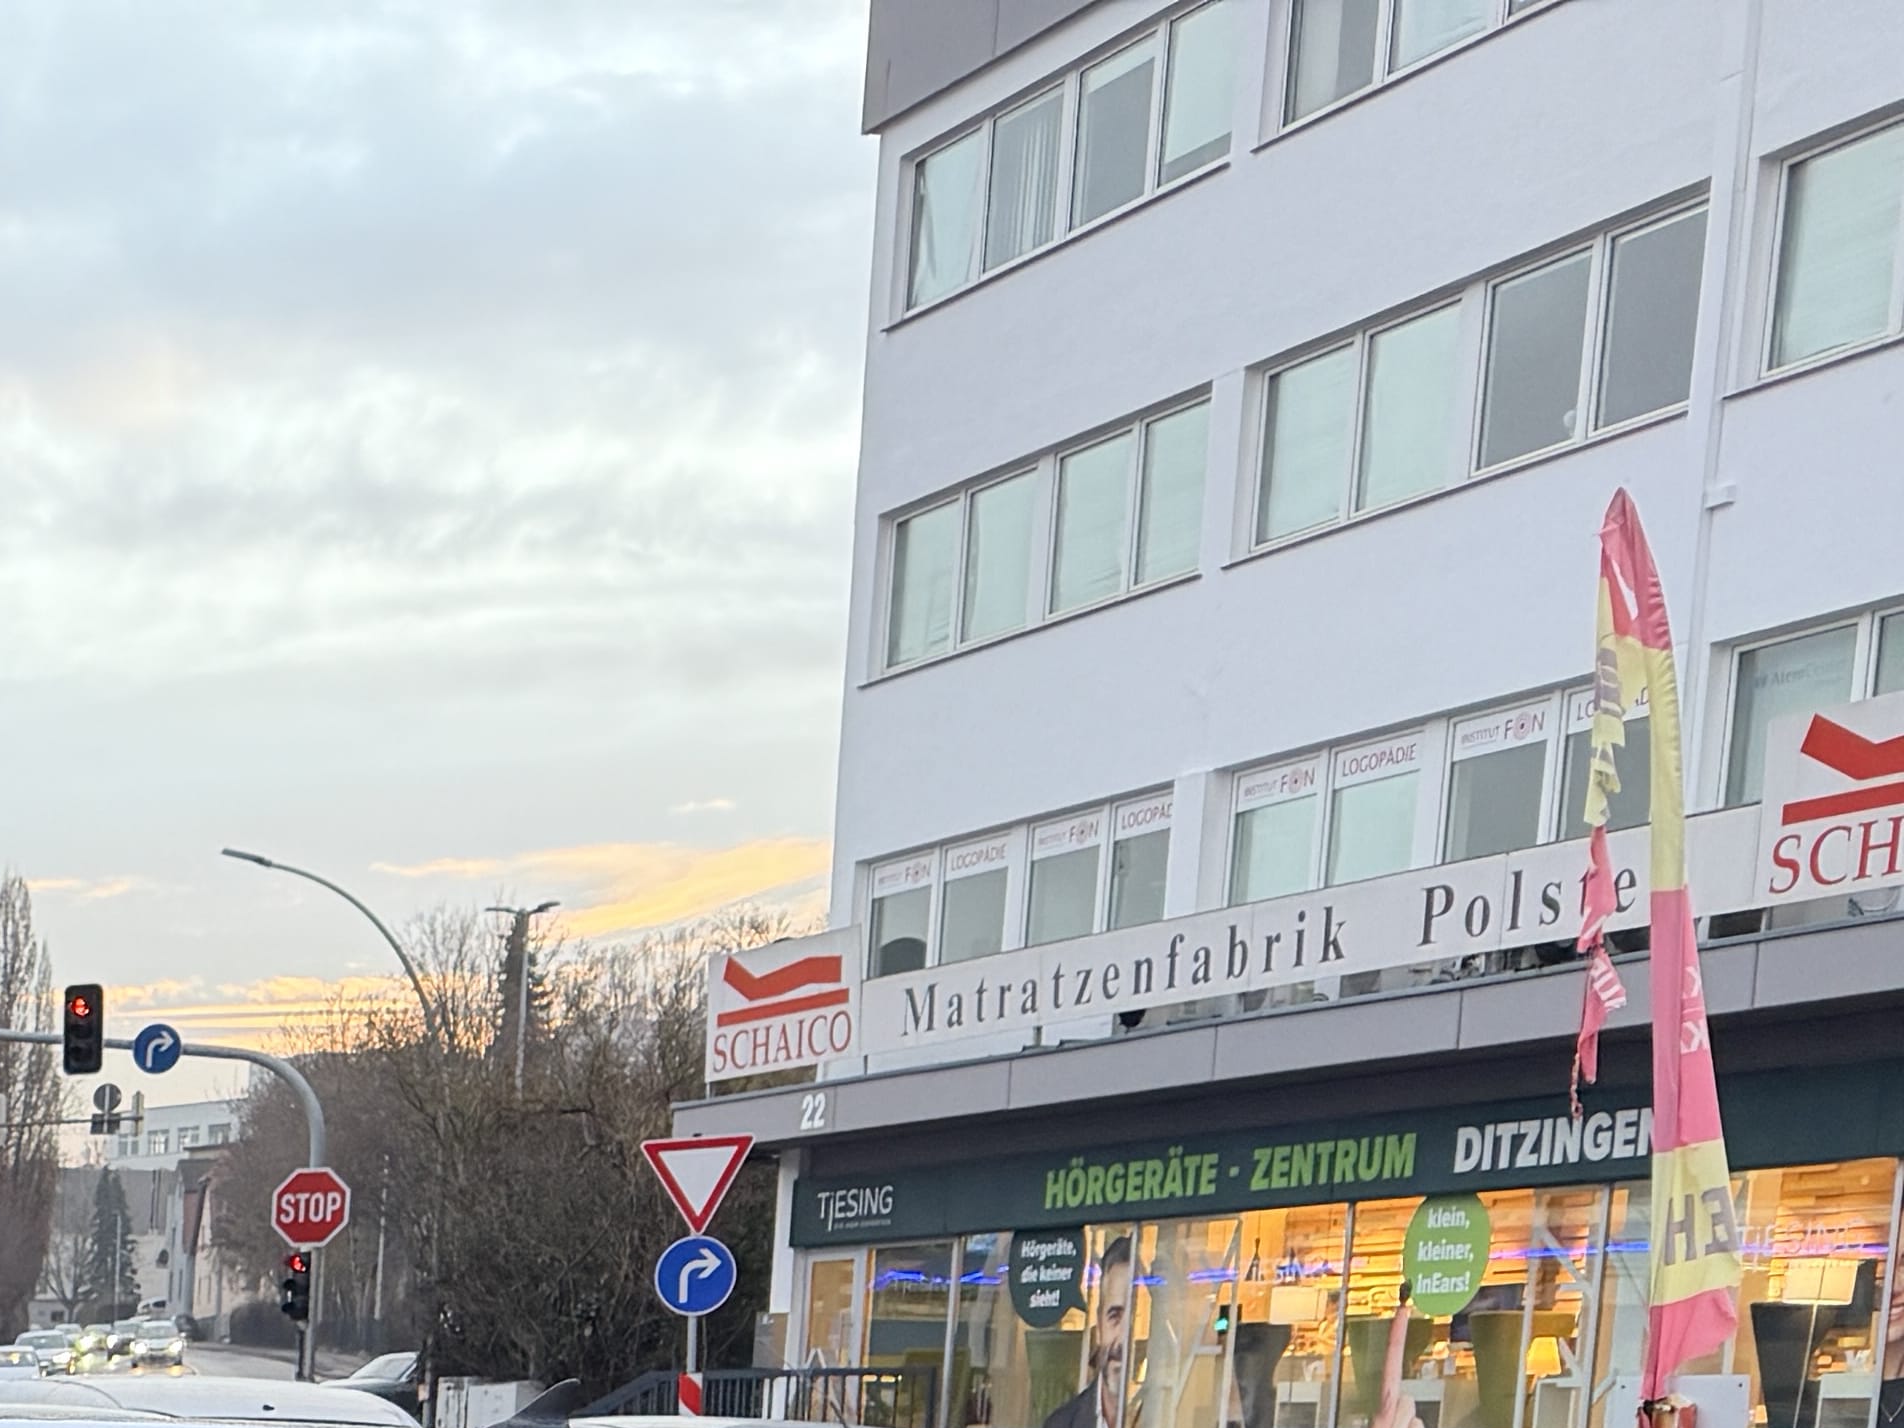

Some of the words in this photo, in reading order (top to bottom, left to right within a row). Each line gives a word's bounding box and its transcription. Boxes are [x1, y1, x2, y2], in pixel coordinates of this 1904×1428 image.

[901, 906, 1347, 1037] Matratzenfabrik
[713, 1010, 852, 1073] SCHAICO
[800, 1092, 826, 1131] 22
[1045, 1145, 1219, 1210] HÖRGERÄTE
[1250, 1133, 1417, 1192] ZENTRUM
[280, 1191, 341, 1223] STOP
[1427, 1206, 1471, 1229] klein,
[1417, 1239, 1474, 1263] kleiner,
